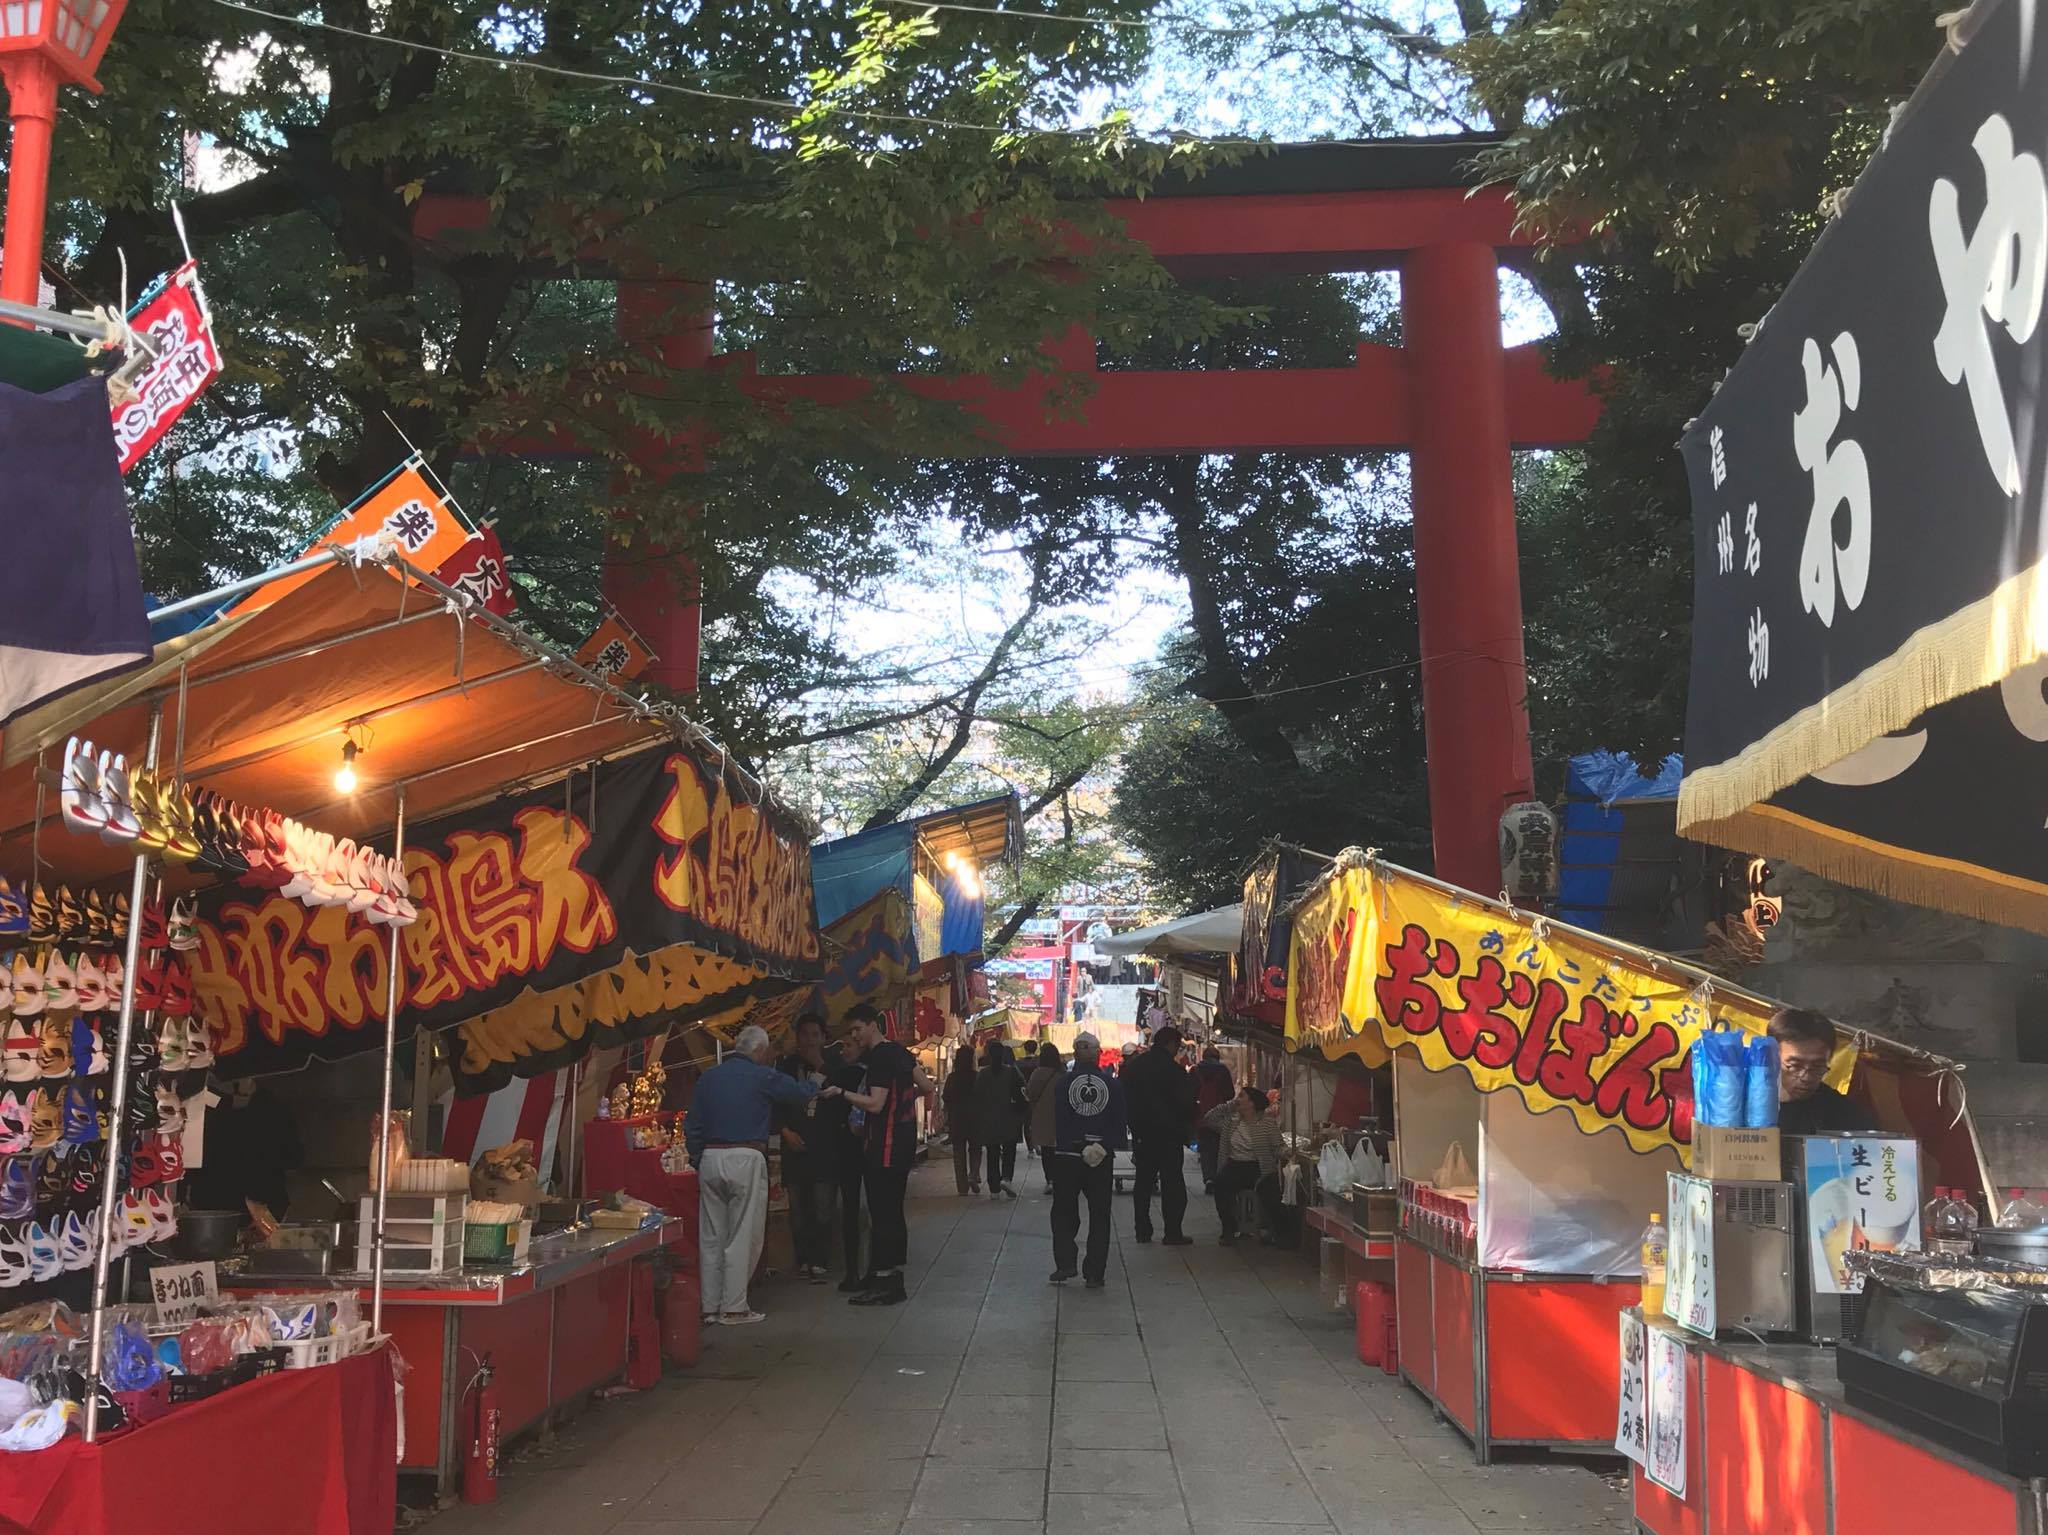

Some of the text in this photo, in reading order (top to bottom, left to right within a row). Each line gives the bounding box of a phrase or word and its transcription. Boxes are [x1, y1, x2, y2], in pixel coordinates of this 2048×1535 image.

[1709, 424, 1734, 576] 信州
[1744, 501, 1769, 689] 名物
[1881, 1145, 1897, 1202] 冷えてる
[155, 1270, 205, 1303] きつね面
[1700, 1194, 1709, 1299] ウーロン
[1690, 1302, 1707, 1329] ¥500
